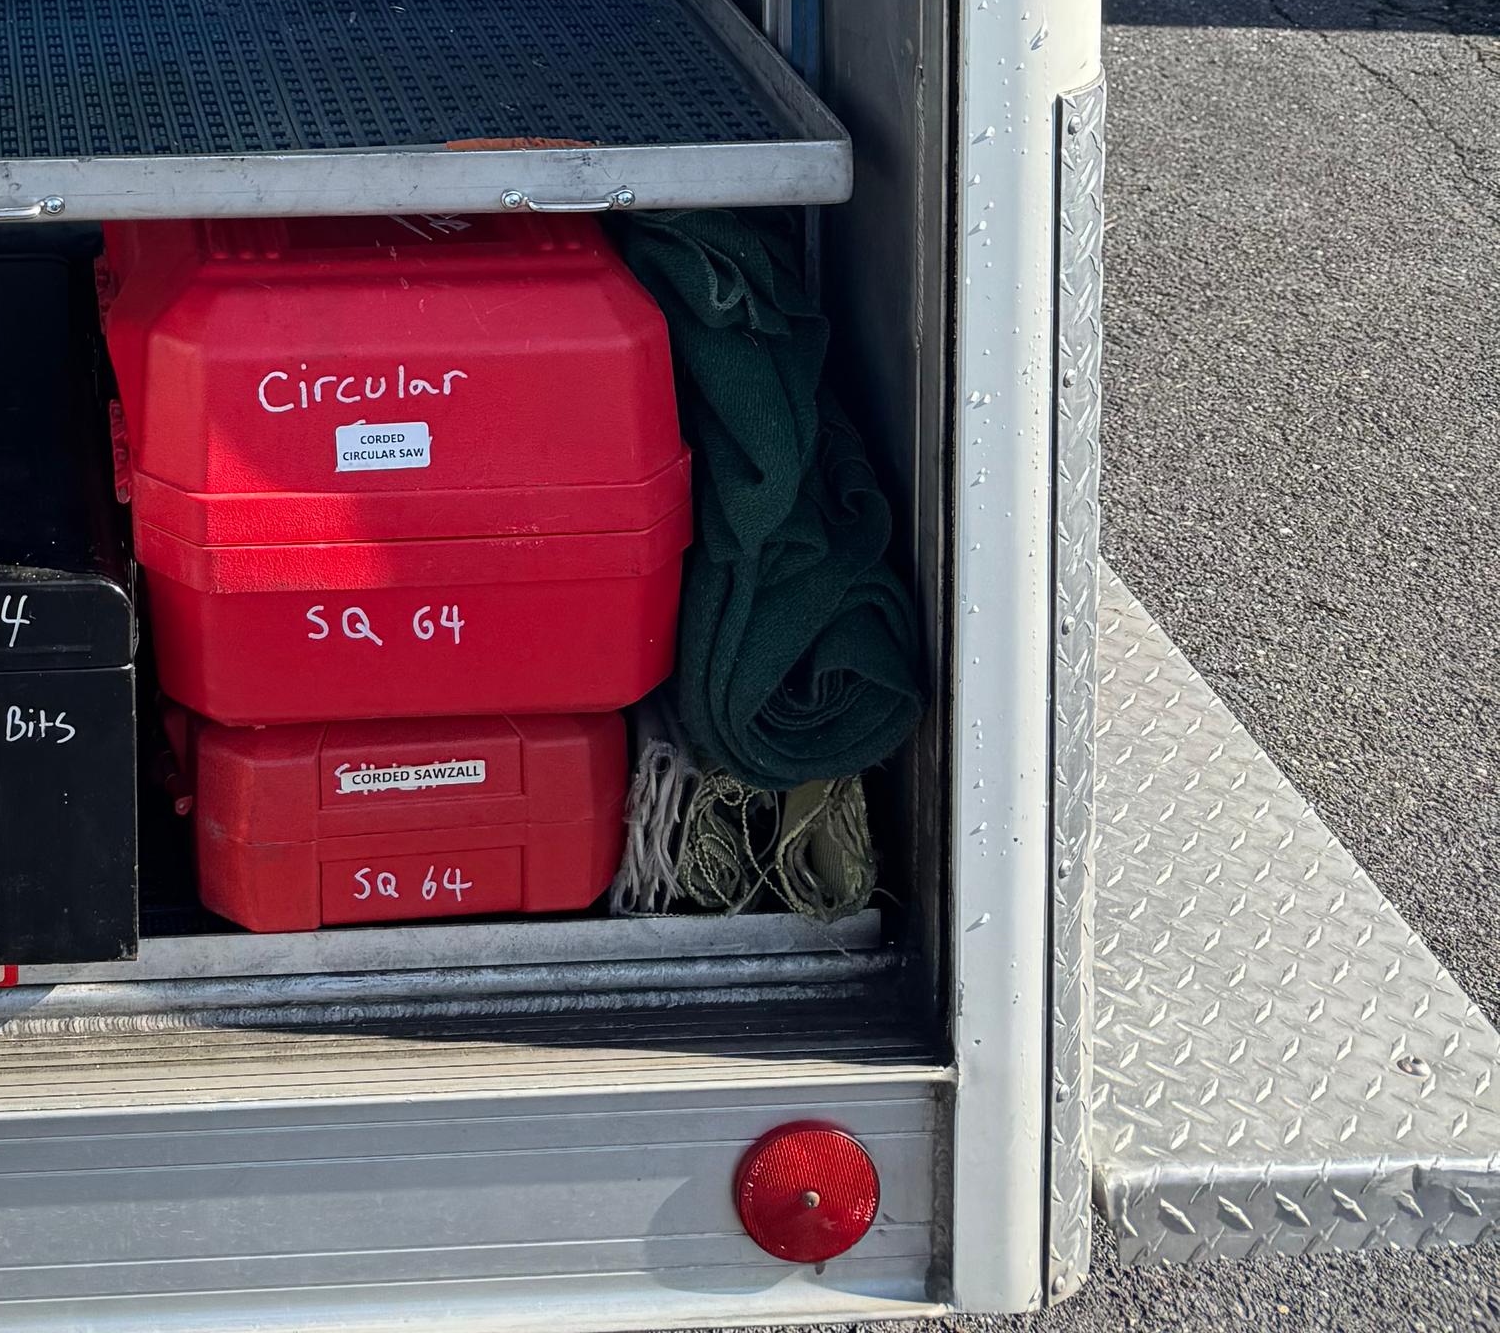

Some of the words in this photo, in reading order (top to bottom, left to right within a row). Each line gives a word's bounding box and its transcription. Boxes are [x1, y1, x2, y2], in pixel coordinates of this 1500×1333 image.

[258, 363, 469, 413] Circular
[342, 449, 396, 461] CIRCULAR
[399, 447, 425, 458] SAW
[360, 433, 405, 445] CORDED
[306, 605, 384, 647] SQ
[413, 604, 465, 645] 64
[6, 705, 76, 743] Bits
[352, 770, 410, 785] CORDED
[414, 765, 481, 781] SAWZALL
[353, 867, 399, 900] SQ
[421, 865, 473, 902] 64
